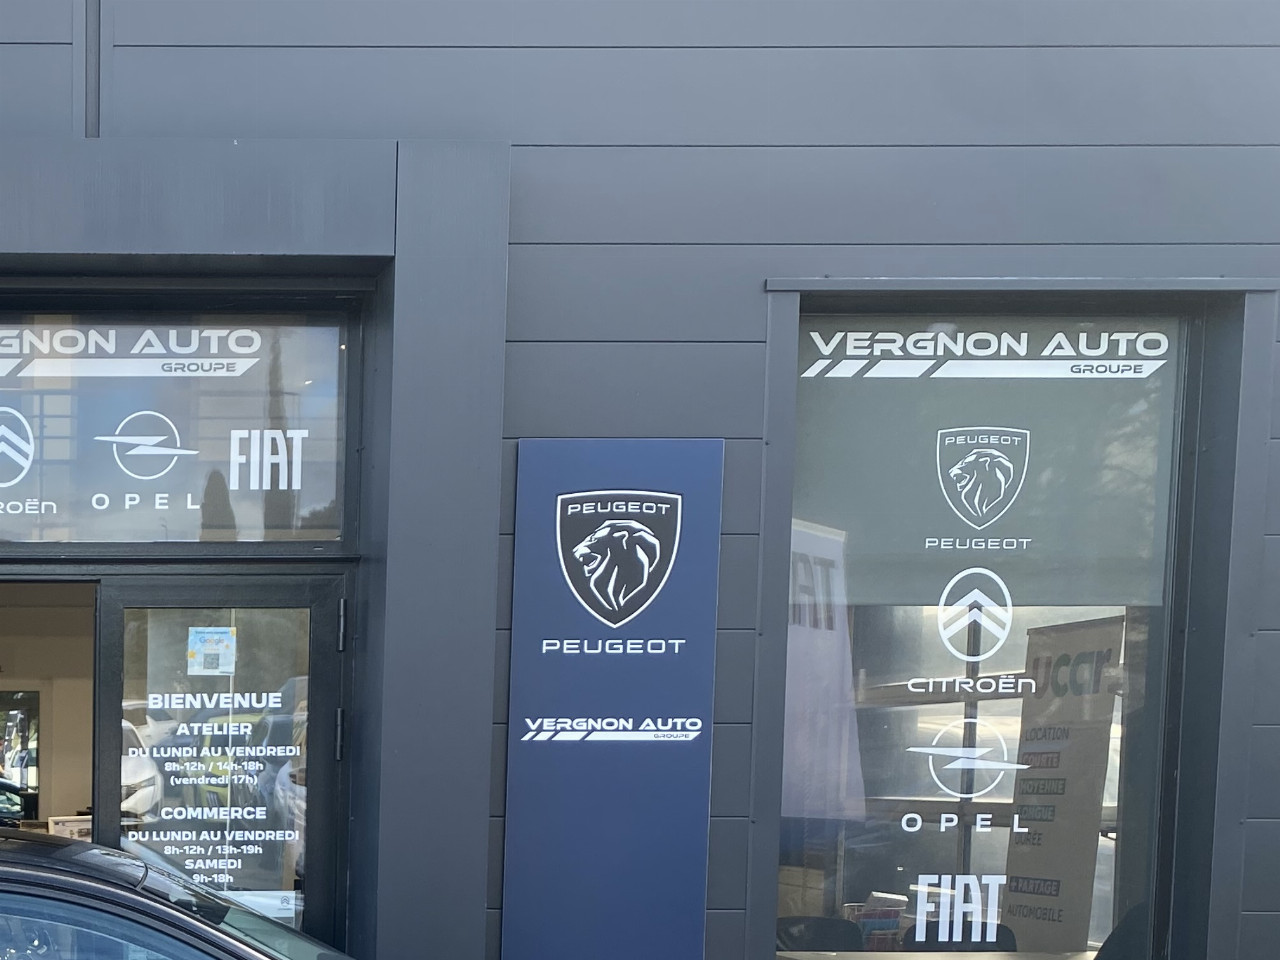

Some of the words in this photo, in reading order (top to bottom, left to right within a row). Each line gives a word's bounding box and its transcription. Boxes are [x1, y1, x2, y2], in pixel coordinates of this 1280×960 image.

[129, 328, 262, 354] AUTO
[809, 331, 1028, 356] VERGNON
[1040, 332, 1169, 357] AUTO
[161, 361, 237, 373] GROUPE
[1070, 363, 1144, 375] GROUPE
[944, 434, 1022, 446] PEUGEOT
[230, 429, 309, 490] FIAT
[91, 494, 200, 510] OPEL
[567, 501, 670, 515] PEUGEOT
[925, 537, 1032, 550] PEUGEOT
[542, 639, 686, 654] PEUGEOT
[148, 693, 282, 709] BIENVENUE
[176, 723, 252, 736] ATELIER
[524, 718, 634, 731] VERGNON
[637, 718, 703, 731] AUTO
[1024, 727, 1070, 741] LOCATION
[128, 748, 150, 758] DU
[152, 747, 197, 758] LUNDI
[200, 747, 222, 758] AU
[225, 746, 301, 757] VENDREDI
[164, 761, 206, 771] 8h-12h
[216, 761, 264, 772] 14h-18h
[169, 775, 229, 786] (vendredi
[232, 775, 258, 786] 17h)
[160, 806, 267, 820] COMMERCE
[901, 813, 1029, 833] OPEL
[128, 831, 149, 841] DU
[152, 831, 196, 841] LUNDI
[199, 831, 221, 841] AU
[224, 830, 300, 841] VENDREDI
[163, 845, 205, 855] 8h-12h
[215, 845, 263, 855] 13h-19h
[184, 859, 242, 869] SAMEDI
[192, 873, 234, 883] 9h-18h
[915, 874, 1007, 943] FIAT
[1007, 904, 1064, 923] AUTOMOBILE
